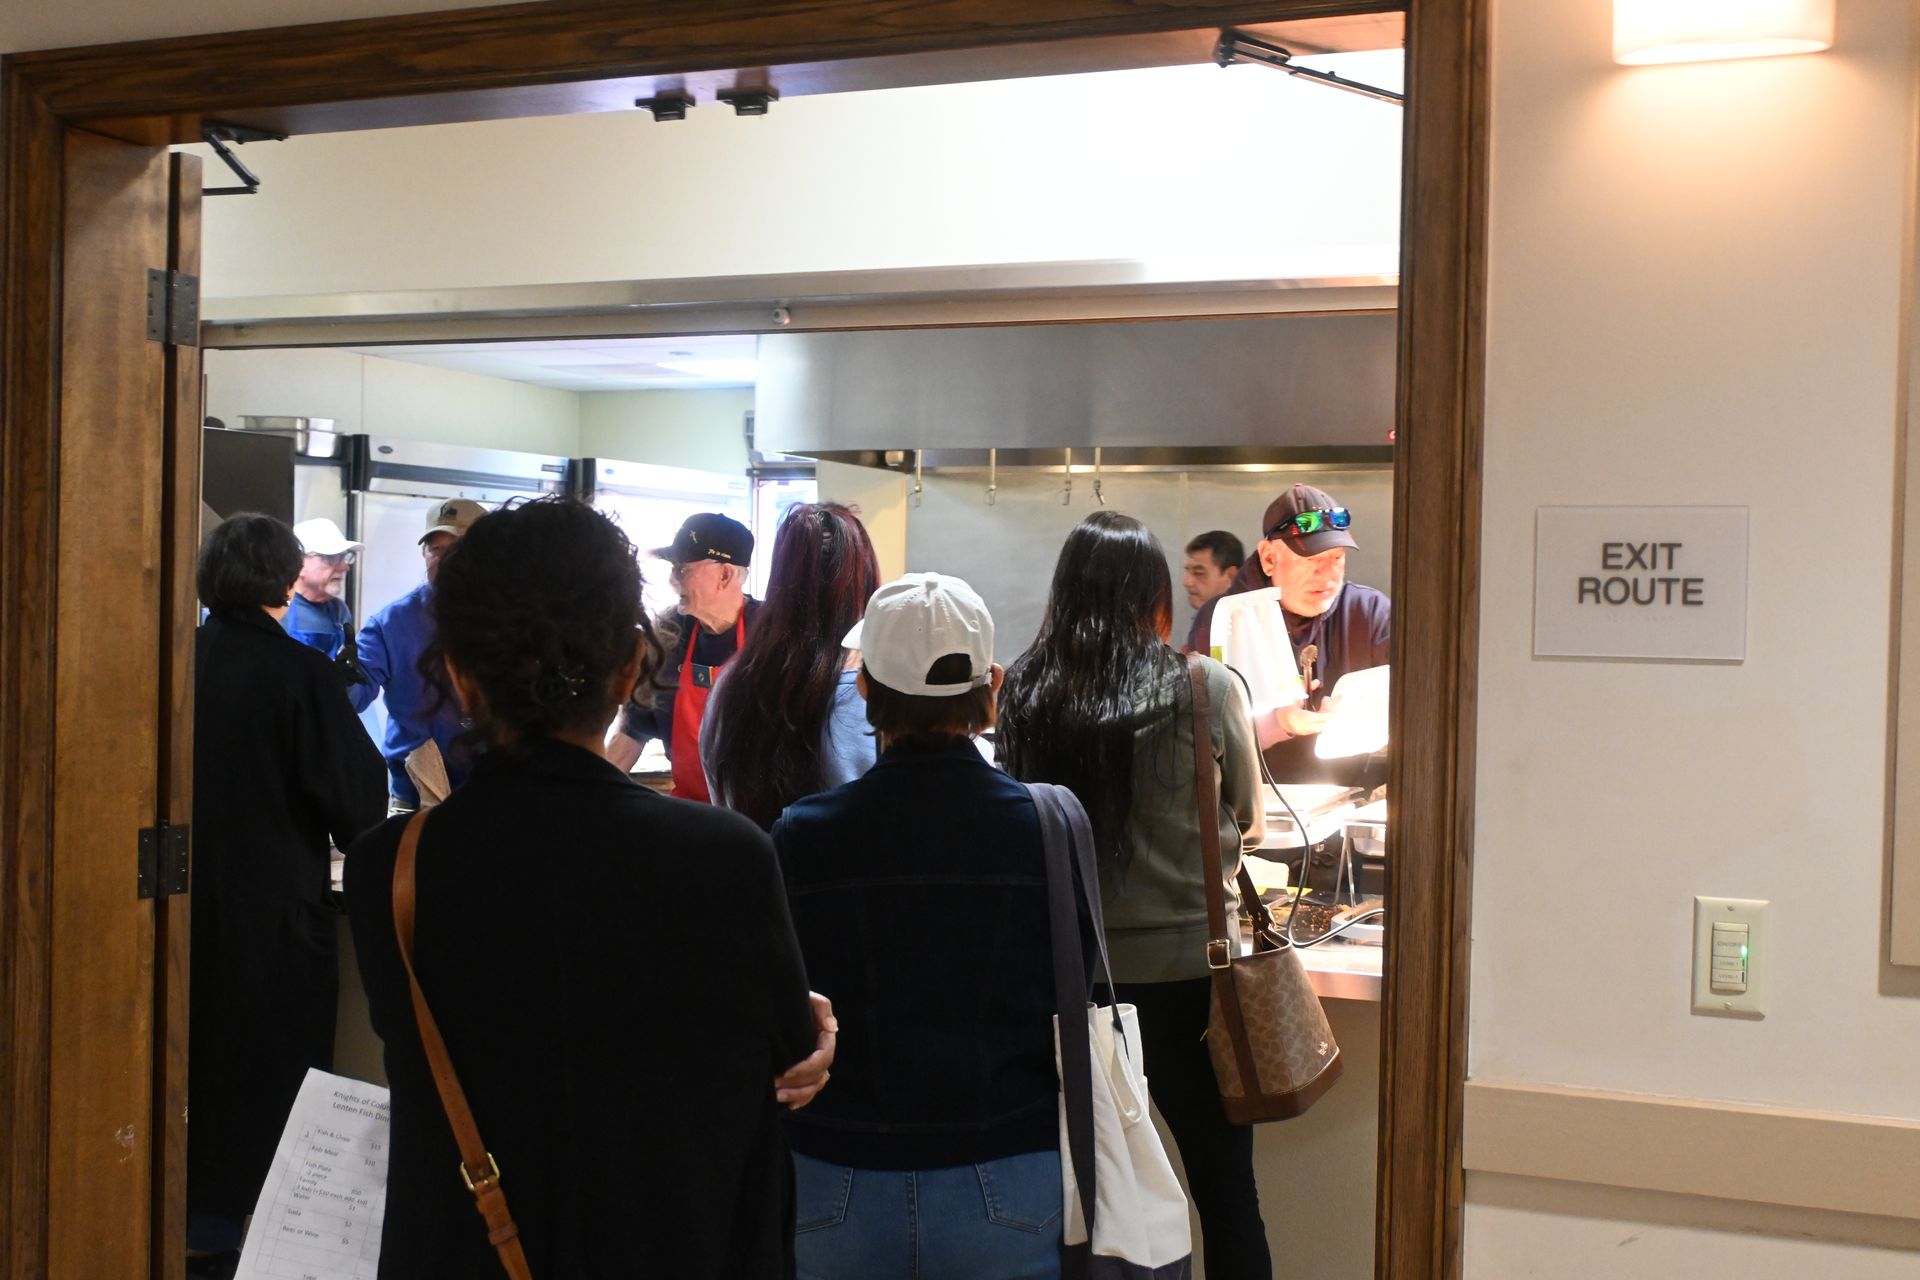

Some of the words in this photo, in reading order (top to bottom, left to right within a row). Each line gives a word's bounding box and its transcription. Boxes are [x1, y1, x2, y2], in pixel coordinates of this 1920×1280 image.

[1602, 543, 1682, 570] EXIT
[1578, 577, 1704, 606] ROUTE
[333, 1091, 360, 1103] Knights
[332, 1102, 358, 1114] Lenten
[359, 1109, 374, 1119] Fish
[293, 1192, 311, 1200] Water
